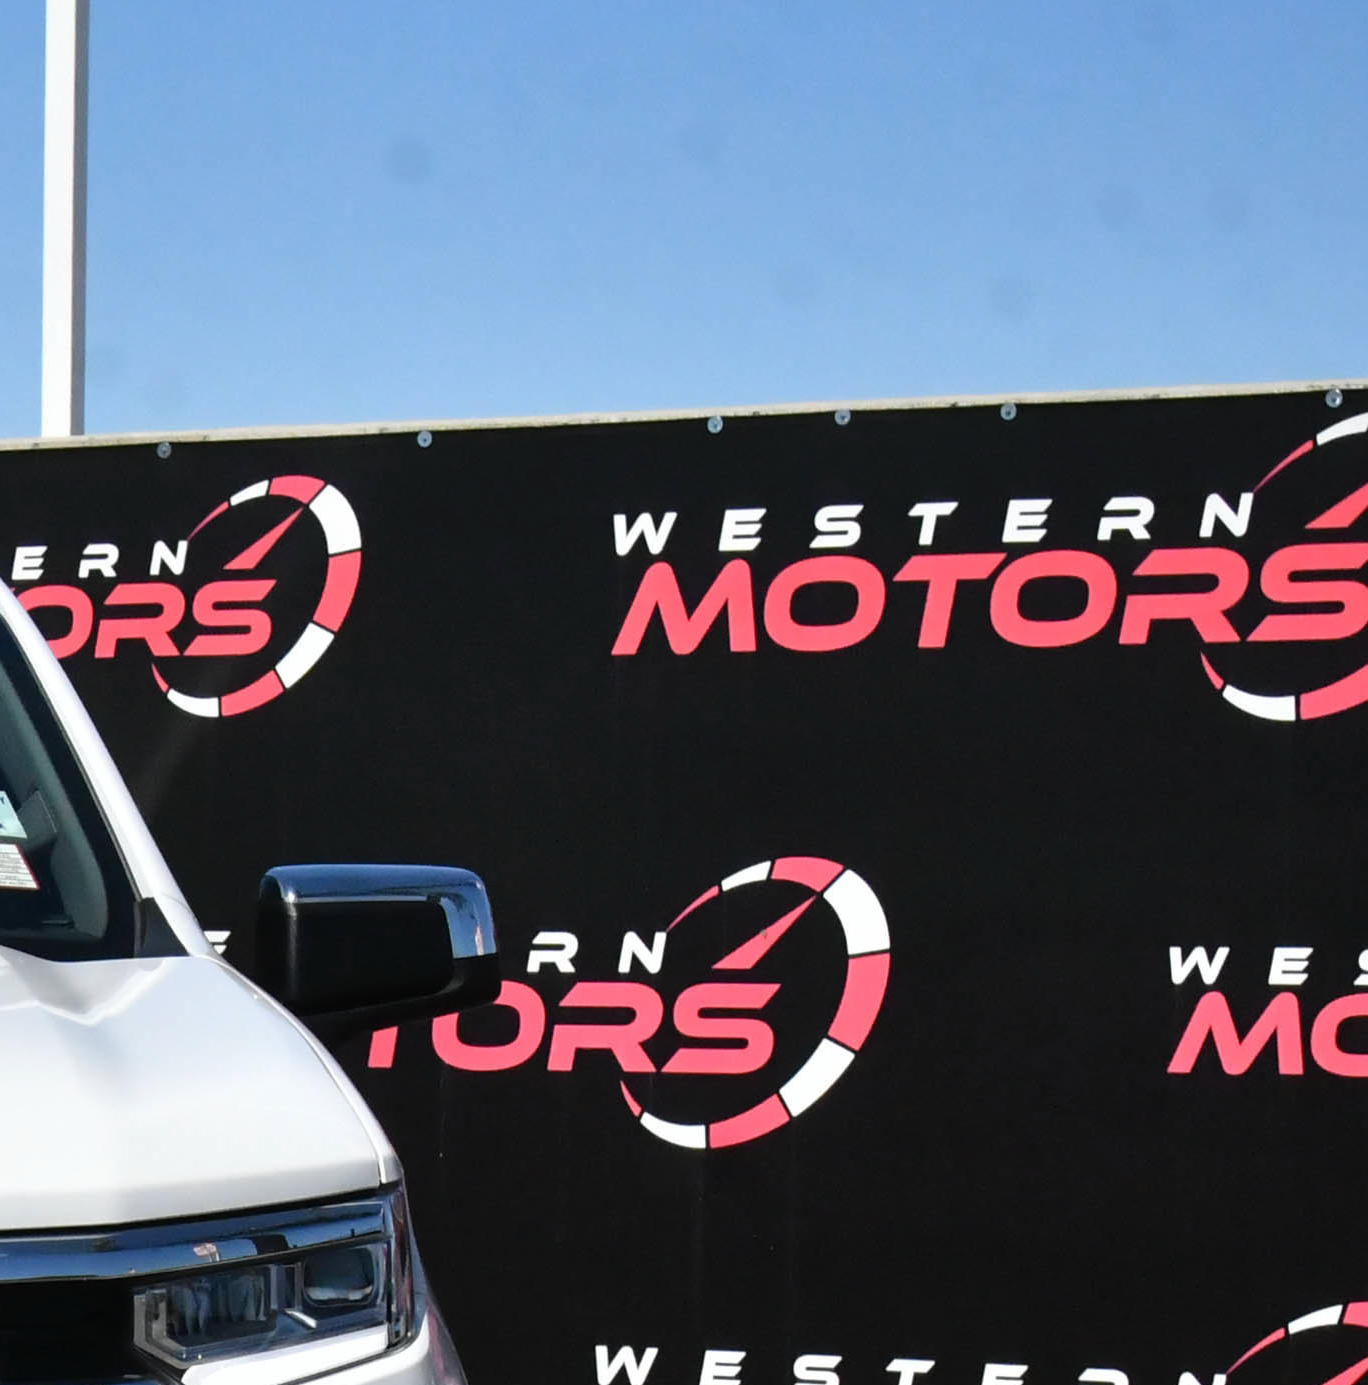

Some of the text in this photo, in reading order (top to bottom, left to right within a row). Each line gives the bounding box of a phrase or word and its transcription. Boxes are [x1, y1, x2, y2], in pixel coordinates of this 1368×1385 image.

[613, 491, 1254, 557] WESTERN
[10, 578, 277, 660] ORS
[610, 541, 1368, 657] MOTORS
[1169, 945, 1368, 986] WE
